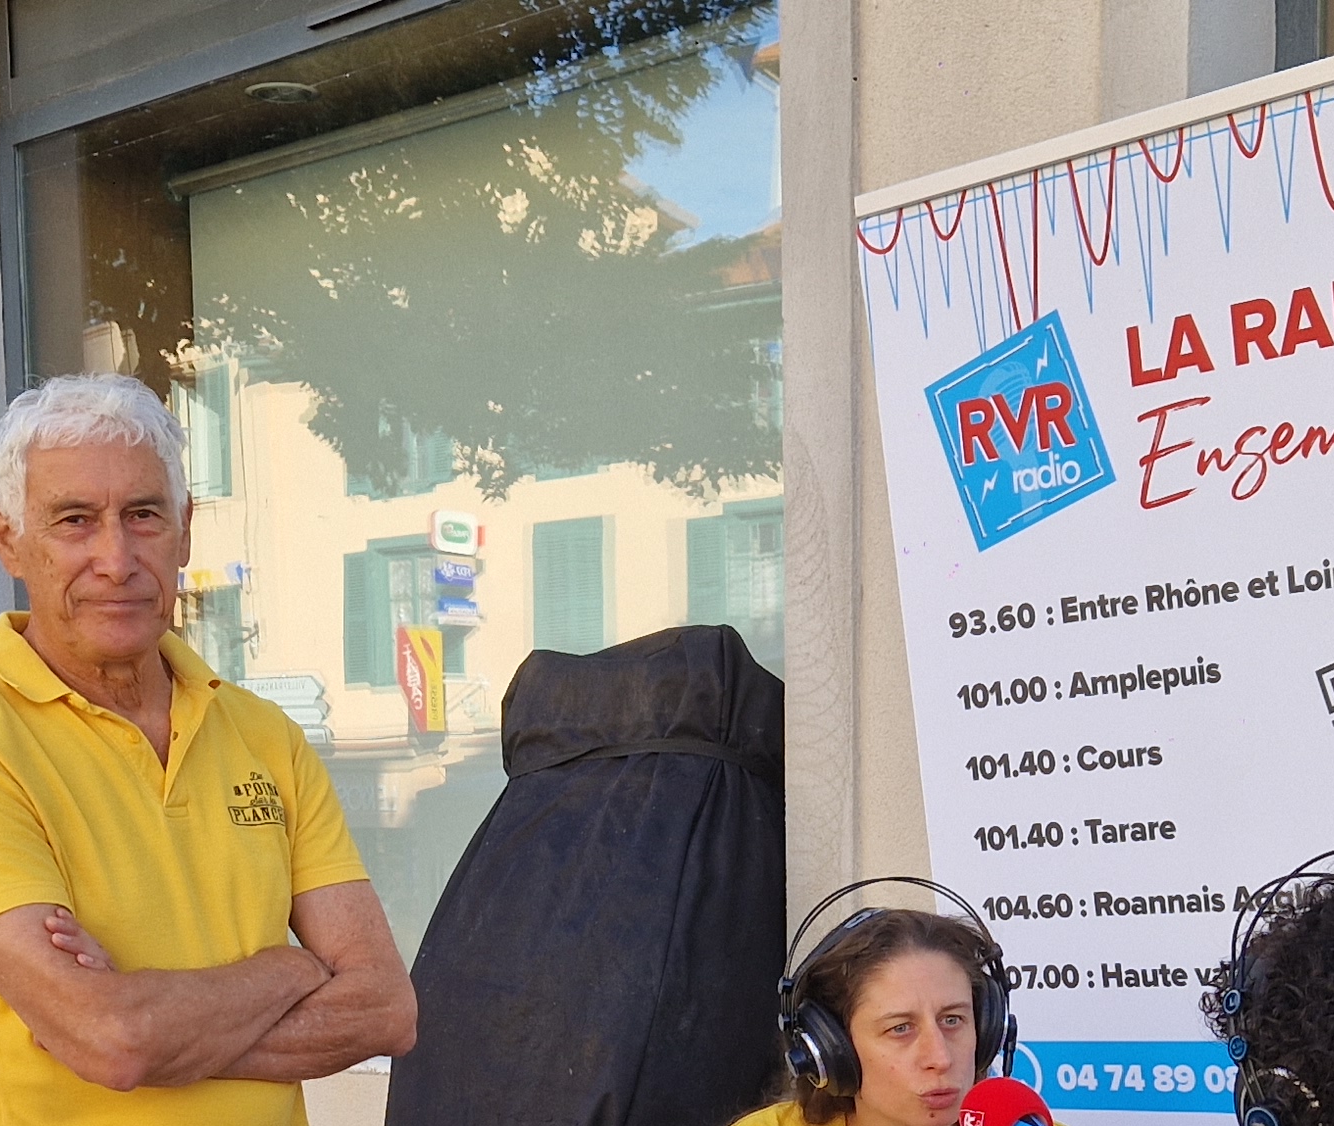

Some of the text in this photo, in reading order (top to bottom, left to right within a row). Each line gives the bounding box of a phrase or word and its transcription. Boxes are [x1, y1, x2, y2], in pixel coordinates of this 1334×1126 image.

[1125, 314, 1214, 386] LA
[955, 381, 1076, 465] RVR
[1012, 453, 1082, 495] radio
[948, 603, 1036, 638] 93.60
[1060, 592, 1139, 625] Entre
[1145, 575, 1239, 613] Rhône
[1249, 569, 1280, 598] et
[957, 675, 1047, 710] 101.00
[1069, 655, 1222, 699] Amplepuis
[966, 748, 1056, 781] 101.40
[1077, 743, 1163, 772] Cours
[242, 782, 279, 797] FOIN
[974, 820, 1064, 851] 101.40
[1084, 814, 1177, 846] Tarare
[983, 895, 1073, 921] 104.60
[1094, 884, 1226, 917] Roannais
[1005, 964, 1079, 990] 07.00
[1101, 963, 1188, 989] Haute
[1194, 967, 1229, 988] va
[1057, 1064, 1095, 1092] 04
[1103, 1064, 1146, 1092] 74
[1153, 1064, 1196, 1093] 89
